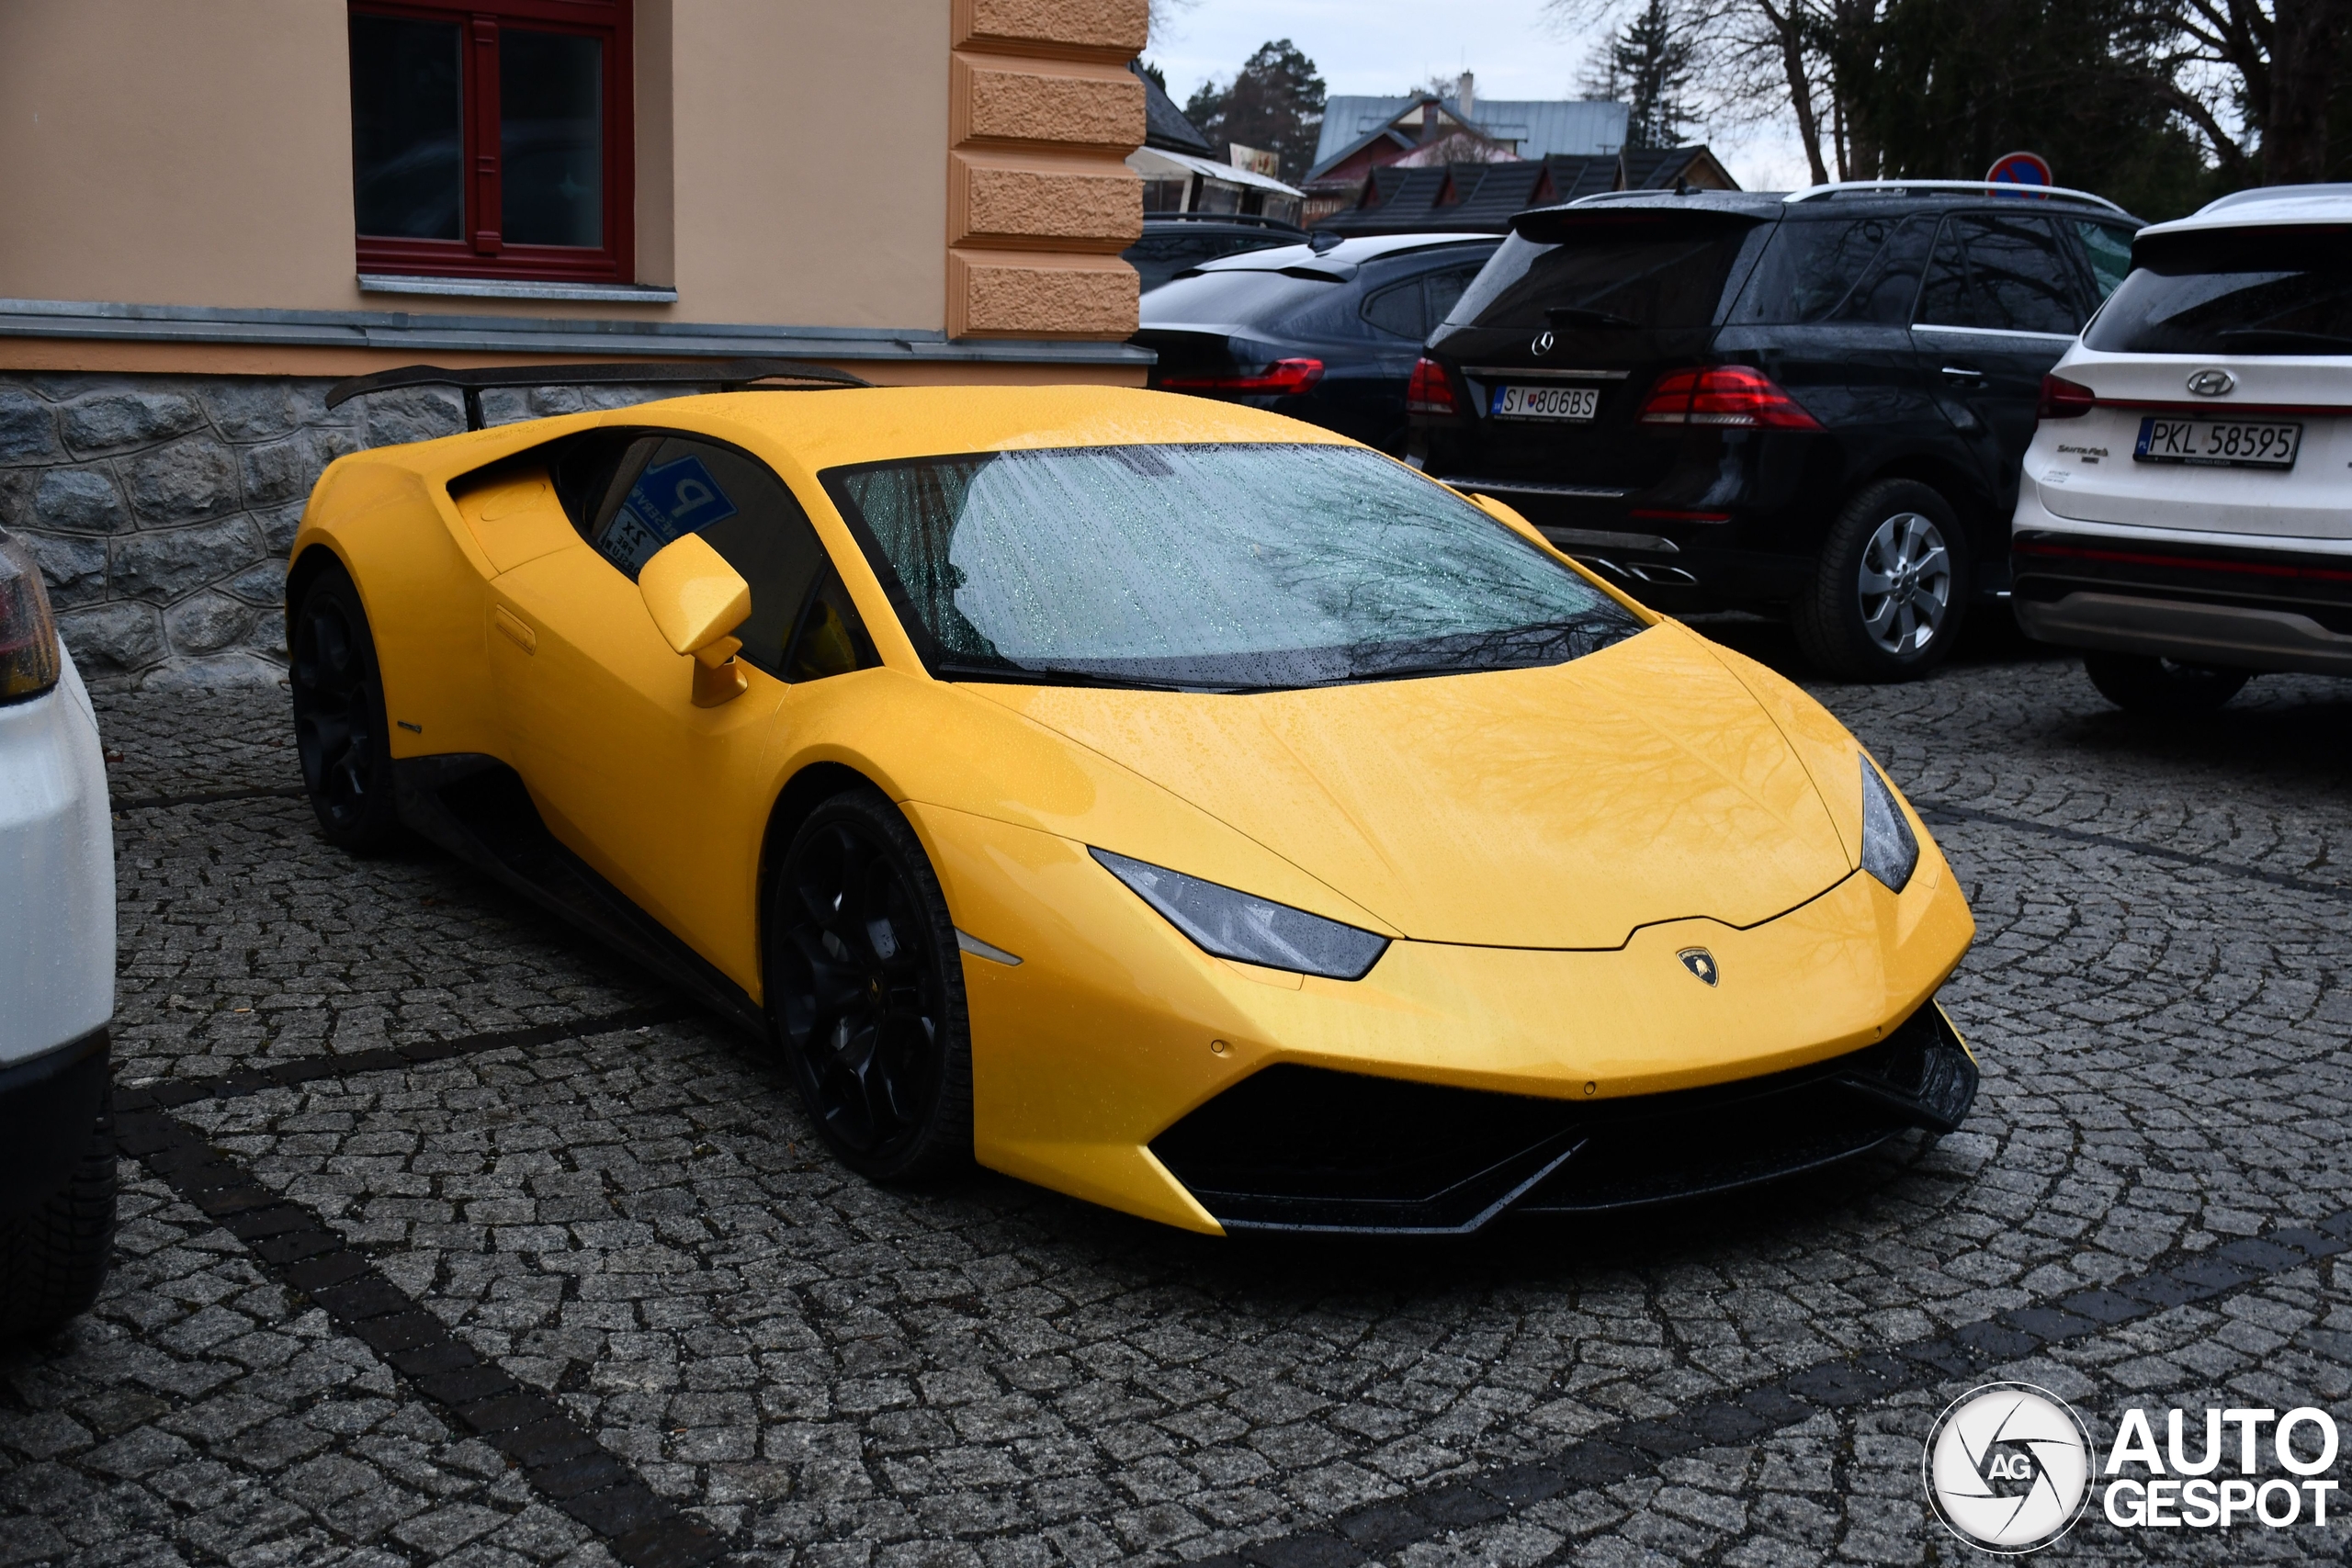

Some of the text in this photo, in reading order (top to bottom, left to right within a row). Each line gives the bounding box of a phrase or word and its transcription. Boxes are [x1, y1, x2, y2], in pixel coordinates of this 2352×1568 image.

[1504, 389, 1595, 415] SI 806BS
[2138, 441, 2147, 449] PL
[2150, 423, 2293, 458] PKL 58595
